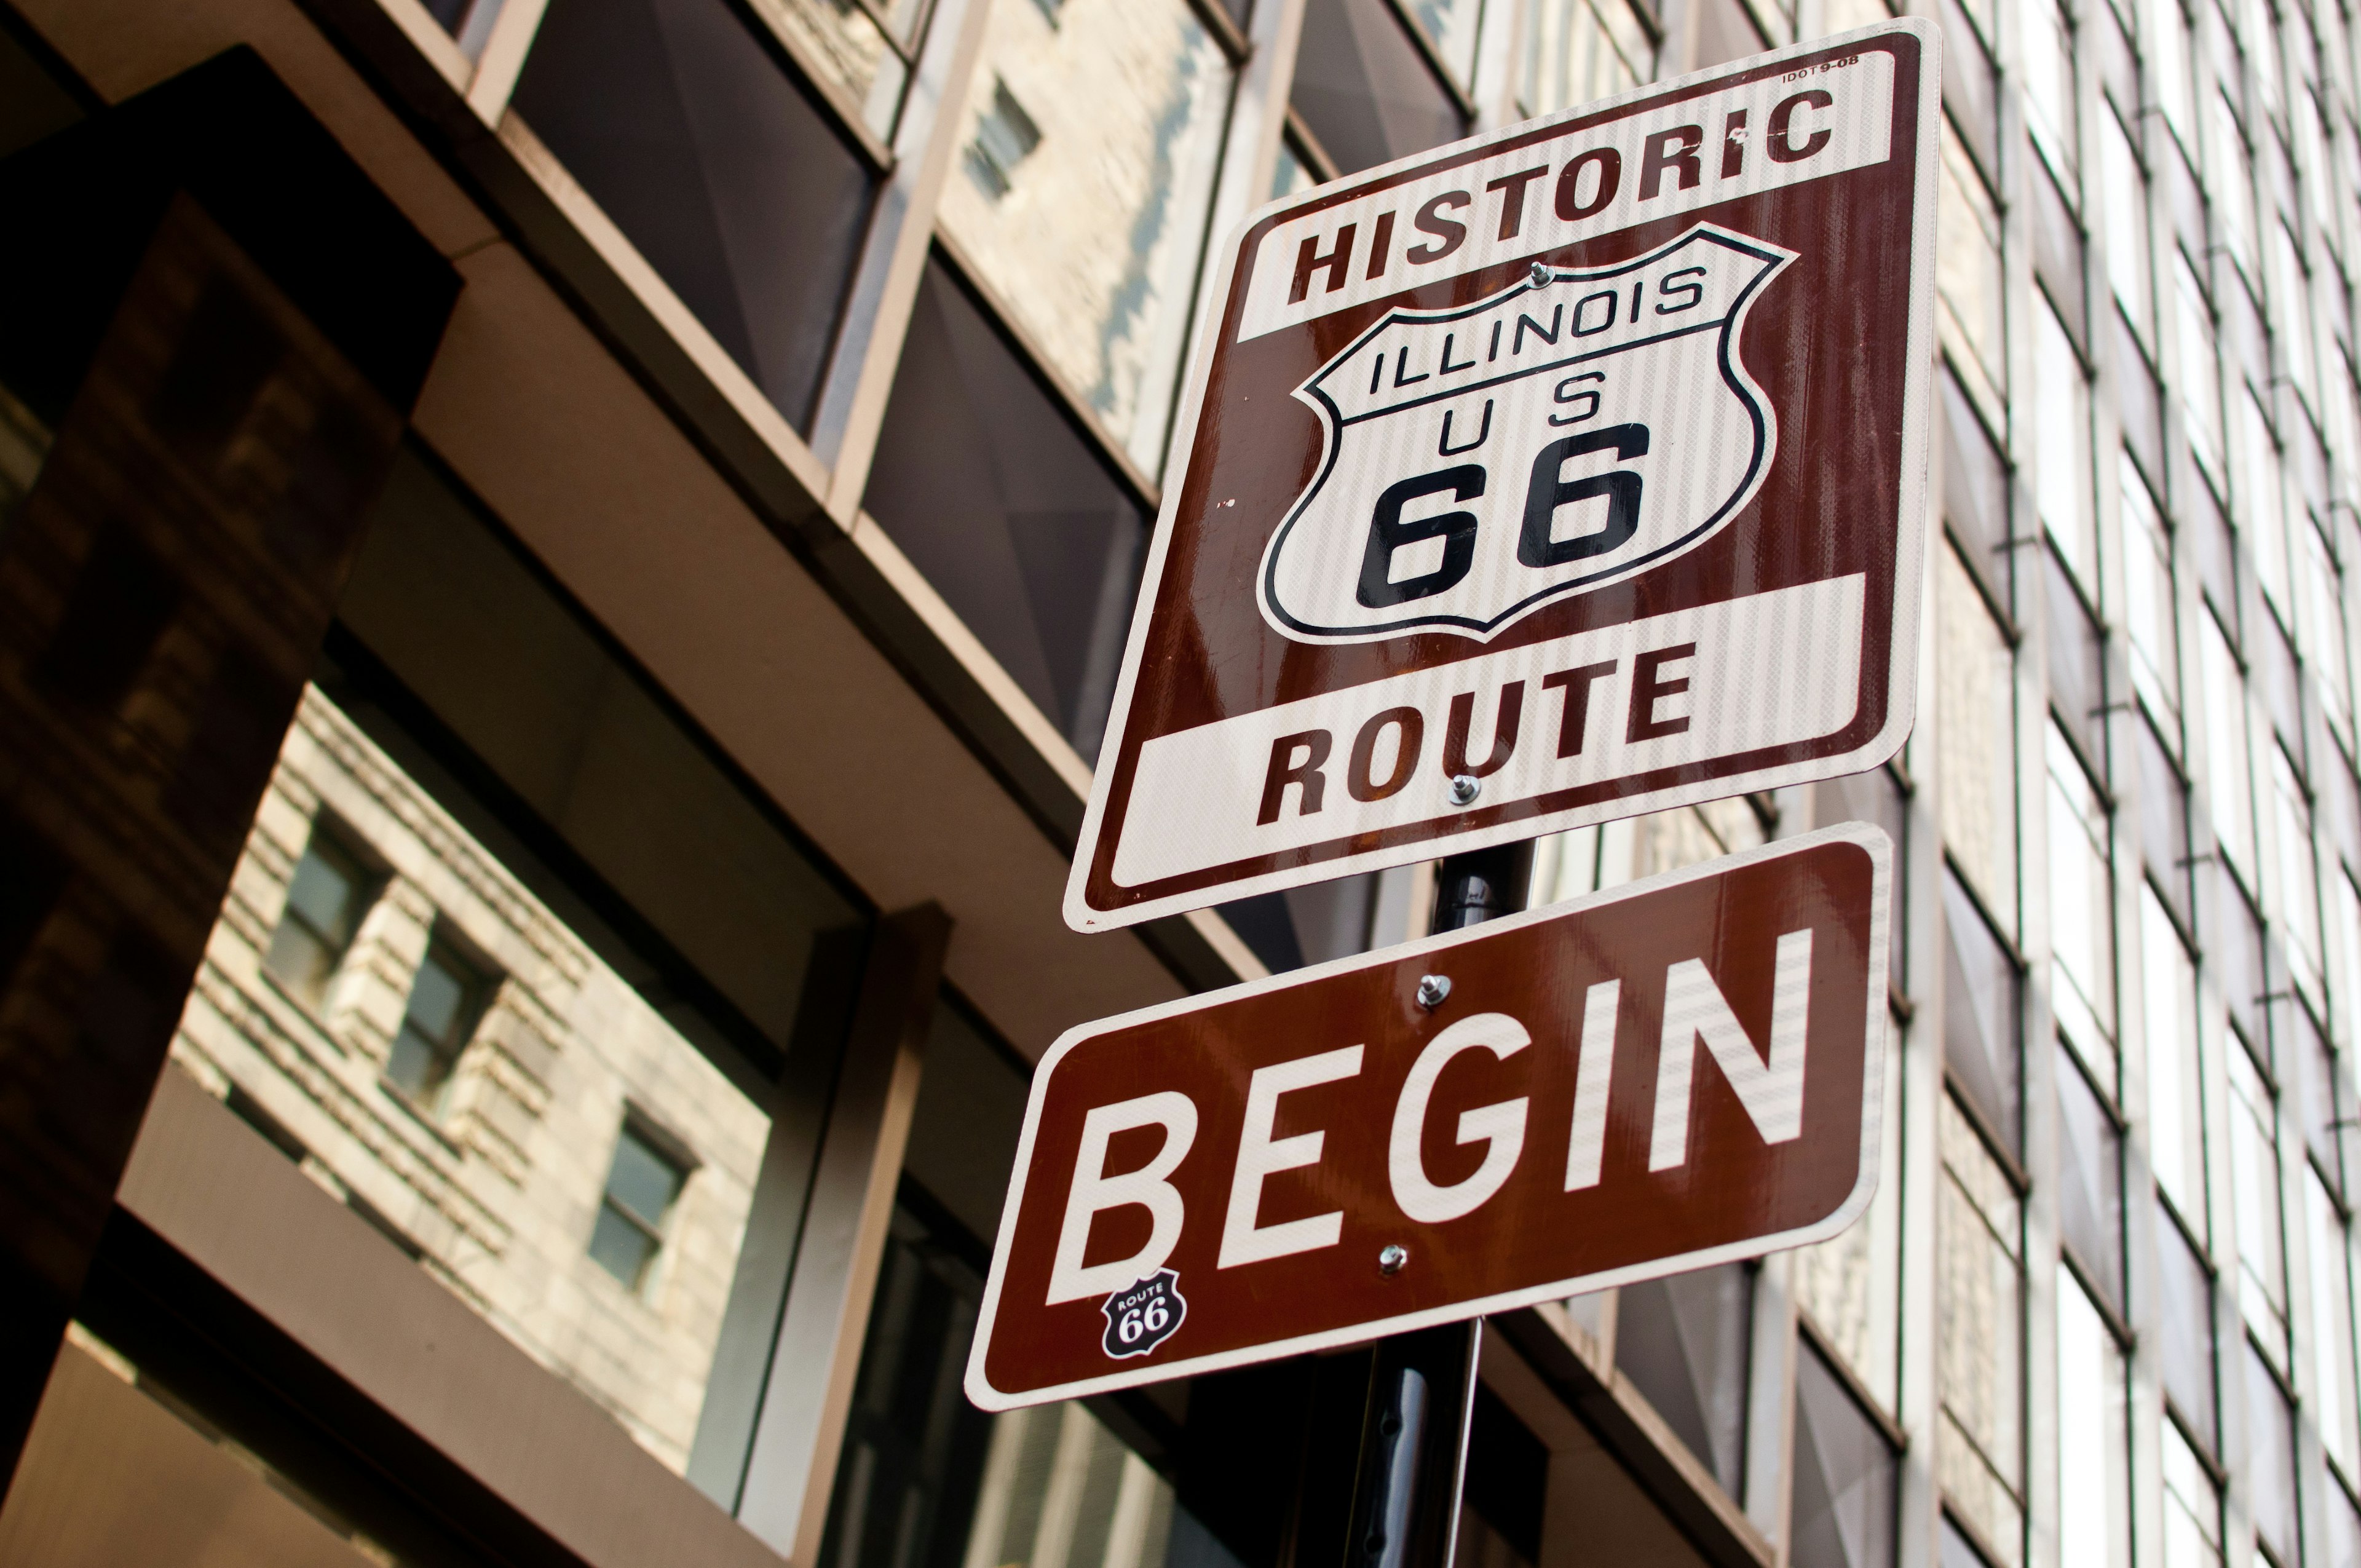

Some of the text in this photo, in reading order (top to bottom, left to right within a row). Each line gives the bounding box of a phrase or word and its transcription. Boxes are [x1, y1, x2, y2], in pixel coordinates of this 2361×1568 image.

[1782, 55, 1859, 84] IDOT 9-08
[1289, 89, 1833, 305] HISTORIC
[1370, 266, 1706, 394] ILLINOIS
[1439, 371, 1605, 457] U S
[1356, 422, 1650, 608] 66
[1256, 641, 1697, 826] ROUTE
[1046, 928, 1814, 1305] BEGIN
[1118, 1282, 1163, 1311] ROUTE
[1119, 1296, 1169, 1343] 66
